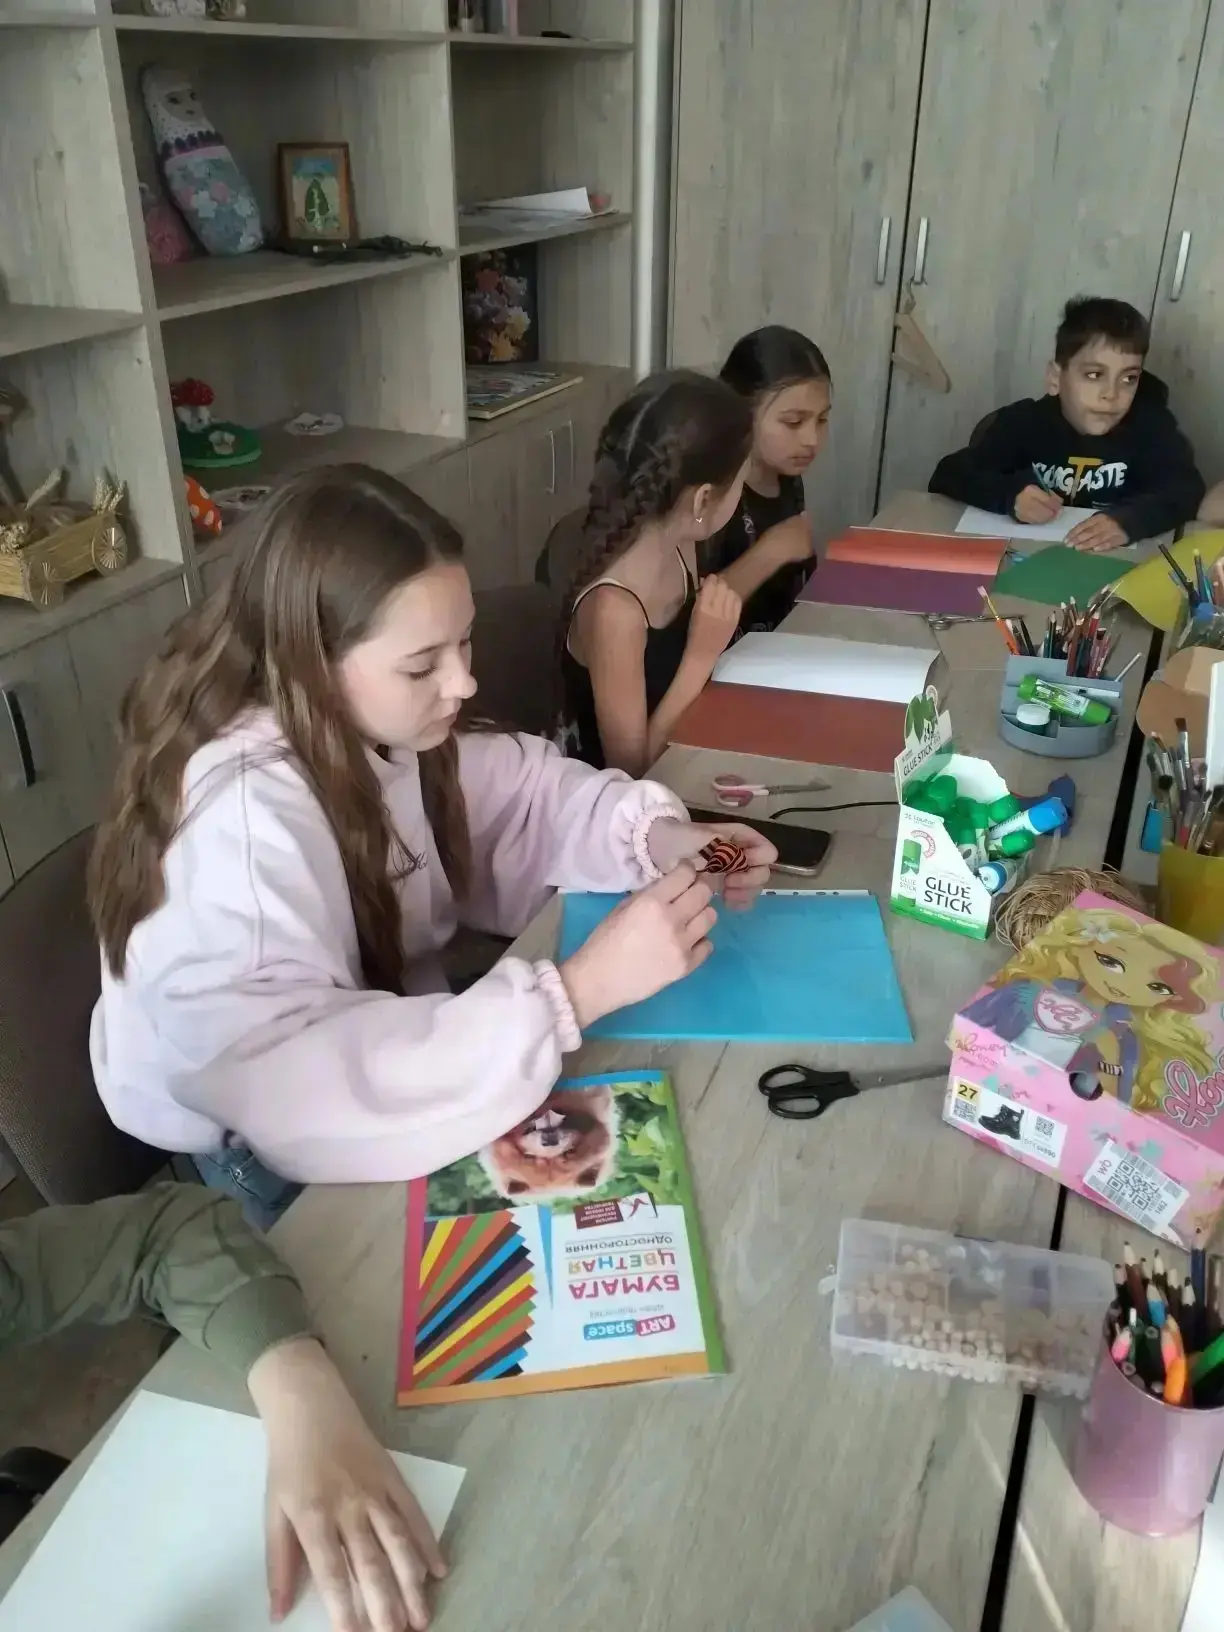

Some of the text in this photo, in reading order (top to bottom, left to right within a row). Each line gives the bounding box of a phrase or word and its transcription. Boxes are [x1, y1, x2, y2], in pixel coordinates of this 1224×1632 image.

[903, 758, 918, 776] GLUE
[918, 745, 933, 763] STICK
[926, 876, 972, 900] GLUE
[924, 890, 973, 915] STICK
[958, 1084, 978, 1100] 27
[565, 1235, 673, 1254] ОДНОСТОРОННЯЯ
[568, 1248, 676, 1274] ЦВЕТНАЯ
[568, 1274, 680, 1300] БУМАГА
